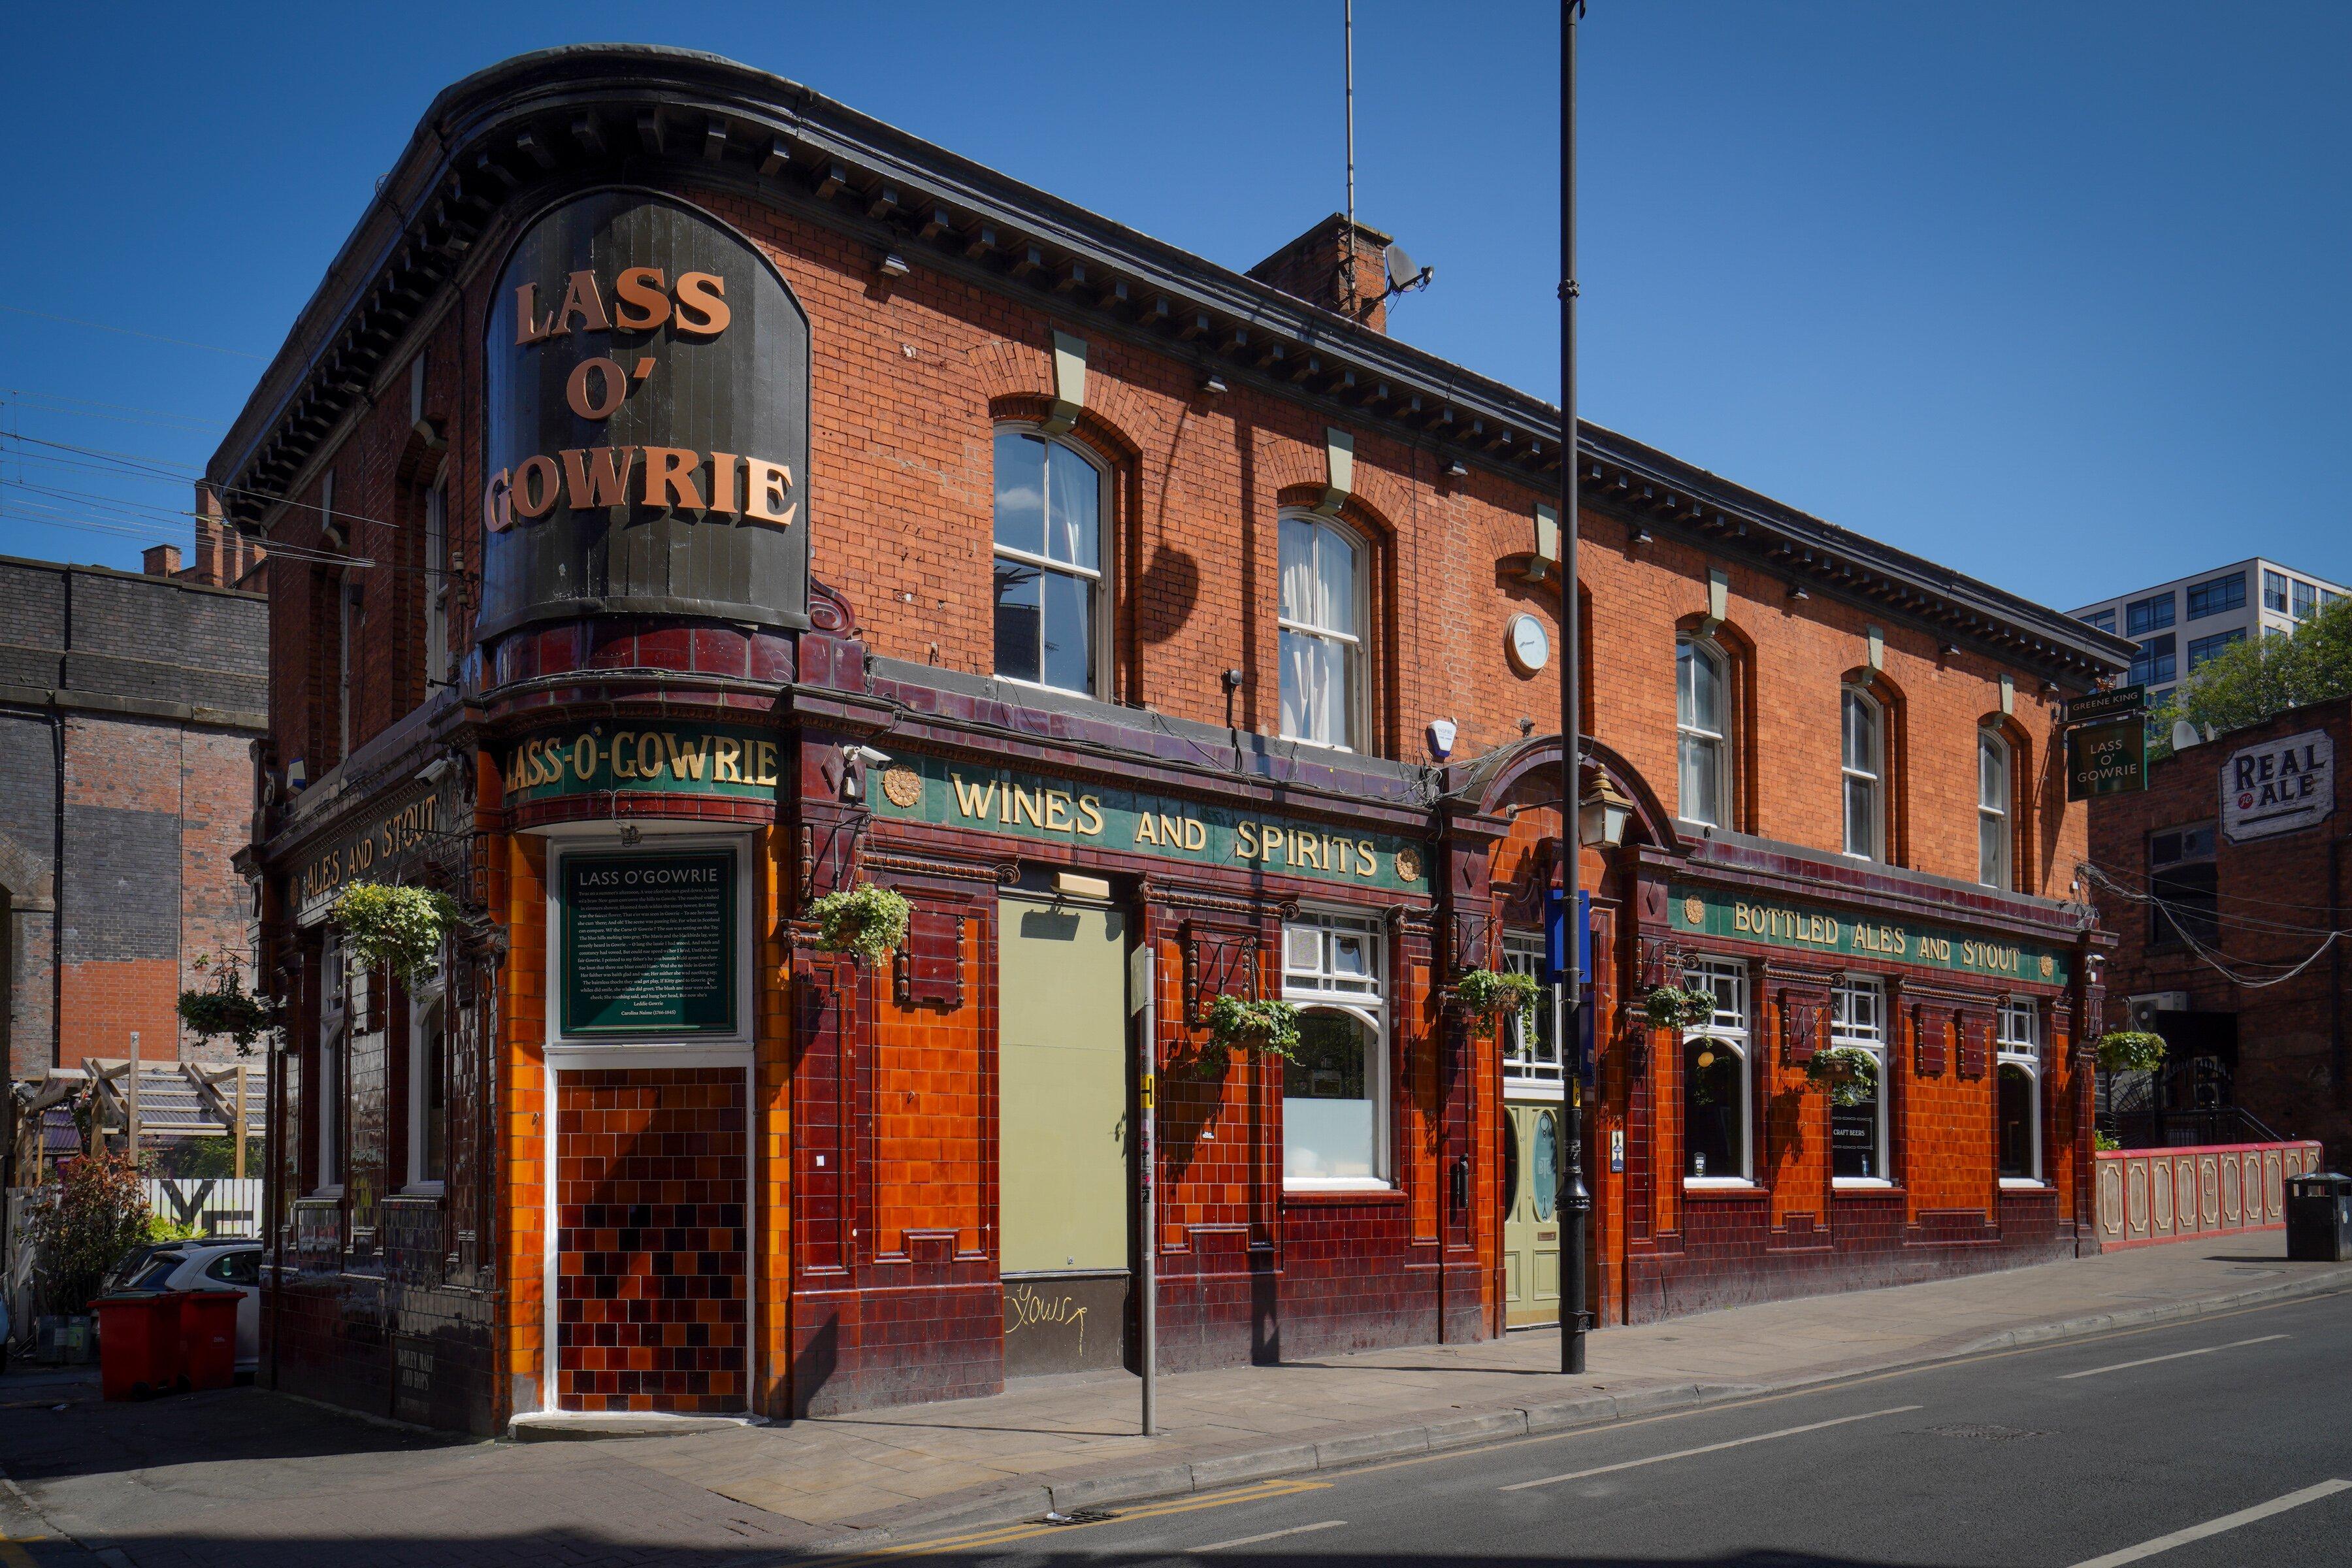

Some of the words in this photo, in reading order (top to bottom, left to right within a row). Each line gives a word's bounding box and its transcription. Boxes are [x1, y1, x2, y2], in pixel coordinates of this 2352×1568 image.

[514, 267, 730, 345] LASS
[566, 357, 656, 421] O'
[485, 446, 797, 533] GOWRIE
[2072, 696, 2110, 711] GREENE
[2113, 691, 2138, 704] KING
[2090, 739, 2123, 755] LASS
[2100, 753, 2115, 766] O'
[2077, 763, 2138, 783] GOWRIE
[2234, 743, 2326, 792] REAL
[2257, 774, 2316, 807] ALE
[951, 772, 1104, 836] WINES
[1135, 812, 1207, 852] AND
[1235, 819, 1379, 877] SPIRITS
[306, 850, 340, 899] ALES
[348, 838, 372, 877] AND
[382, 794, 437, 858] STOUT
[580, 872, 619, 886] LASS
[625, 868, 717, 885] O'GOWRIE
[1734, 901, 1838, 945] BOTTLED
[1852, 922, 1906, 955] ALES
[1919, 936, 1951, 962] AND
[1962, 938, 2021, 973] STOUT
[397, 1348, 417, 1369] BARLEY
[419, 1352, 434, 1373] MALT
[402, 1369, 414, 1387] AND
[414, 1371, 429, 1391] HOPS
